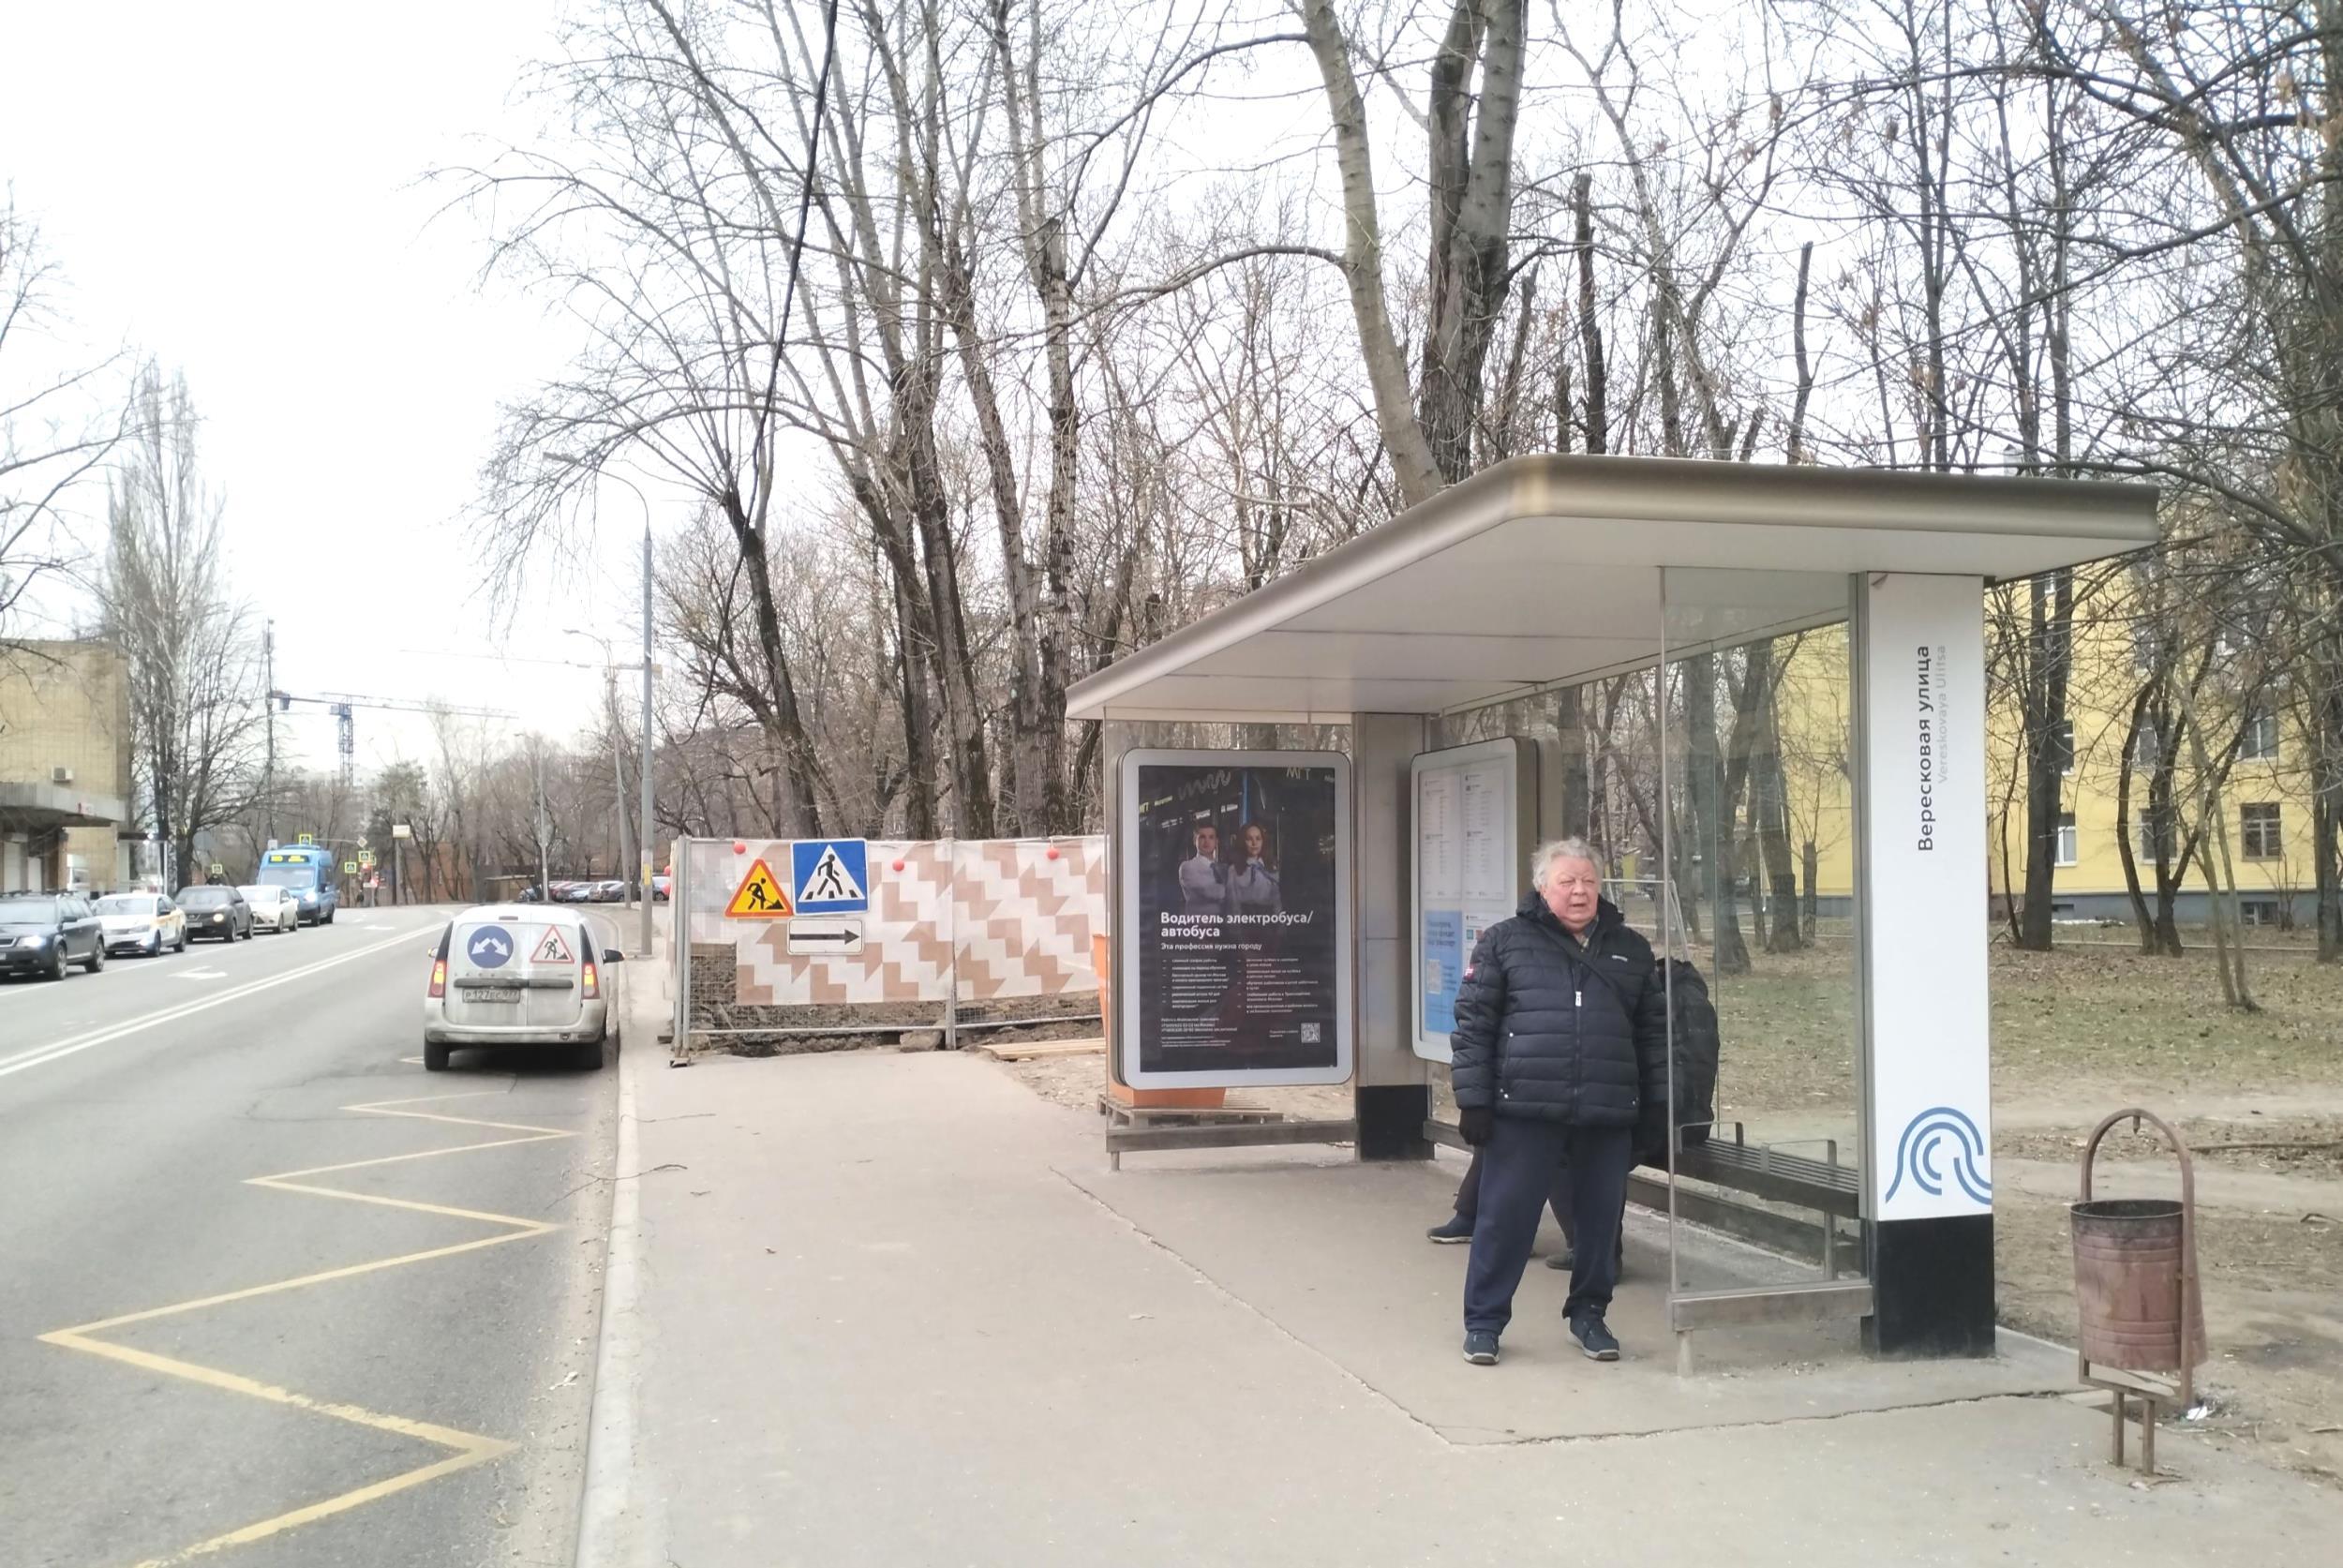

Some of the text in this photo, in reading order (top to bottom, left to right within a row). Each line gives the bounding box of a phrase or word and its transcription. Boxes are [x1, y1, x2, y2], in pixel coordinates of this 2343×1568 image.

[1935, 645, 1950, 784] Vereskovaya Ulitsa
[1917, 645, 1936, 852] Вересковая улица
[1160, 910, 1314, 927] Водитель электробуса/
[1160, 924, 1221, 940] автобуса
[1160, 942, 1262, 951] Эта профессия нужна городу
